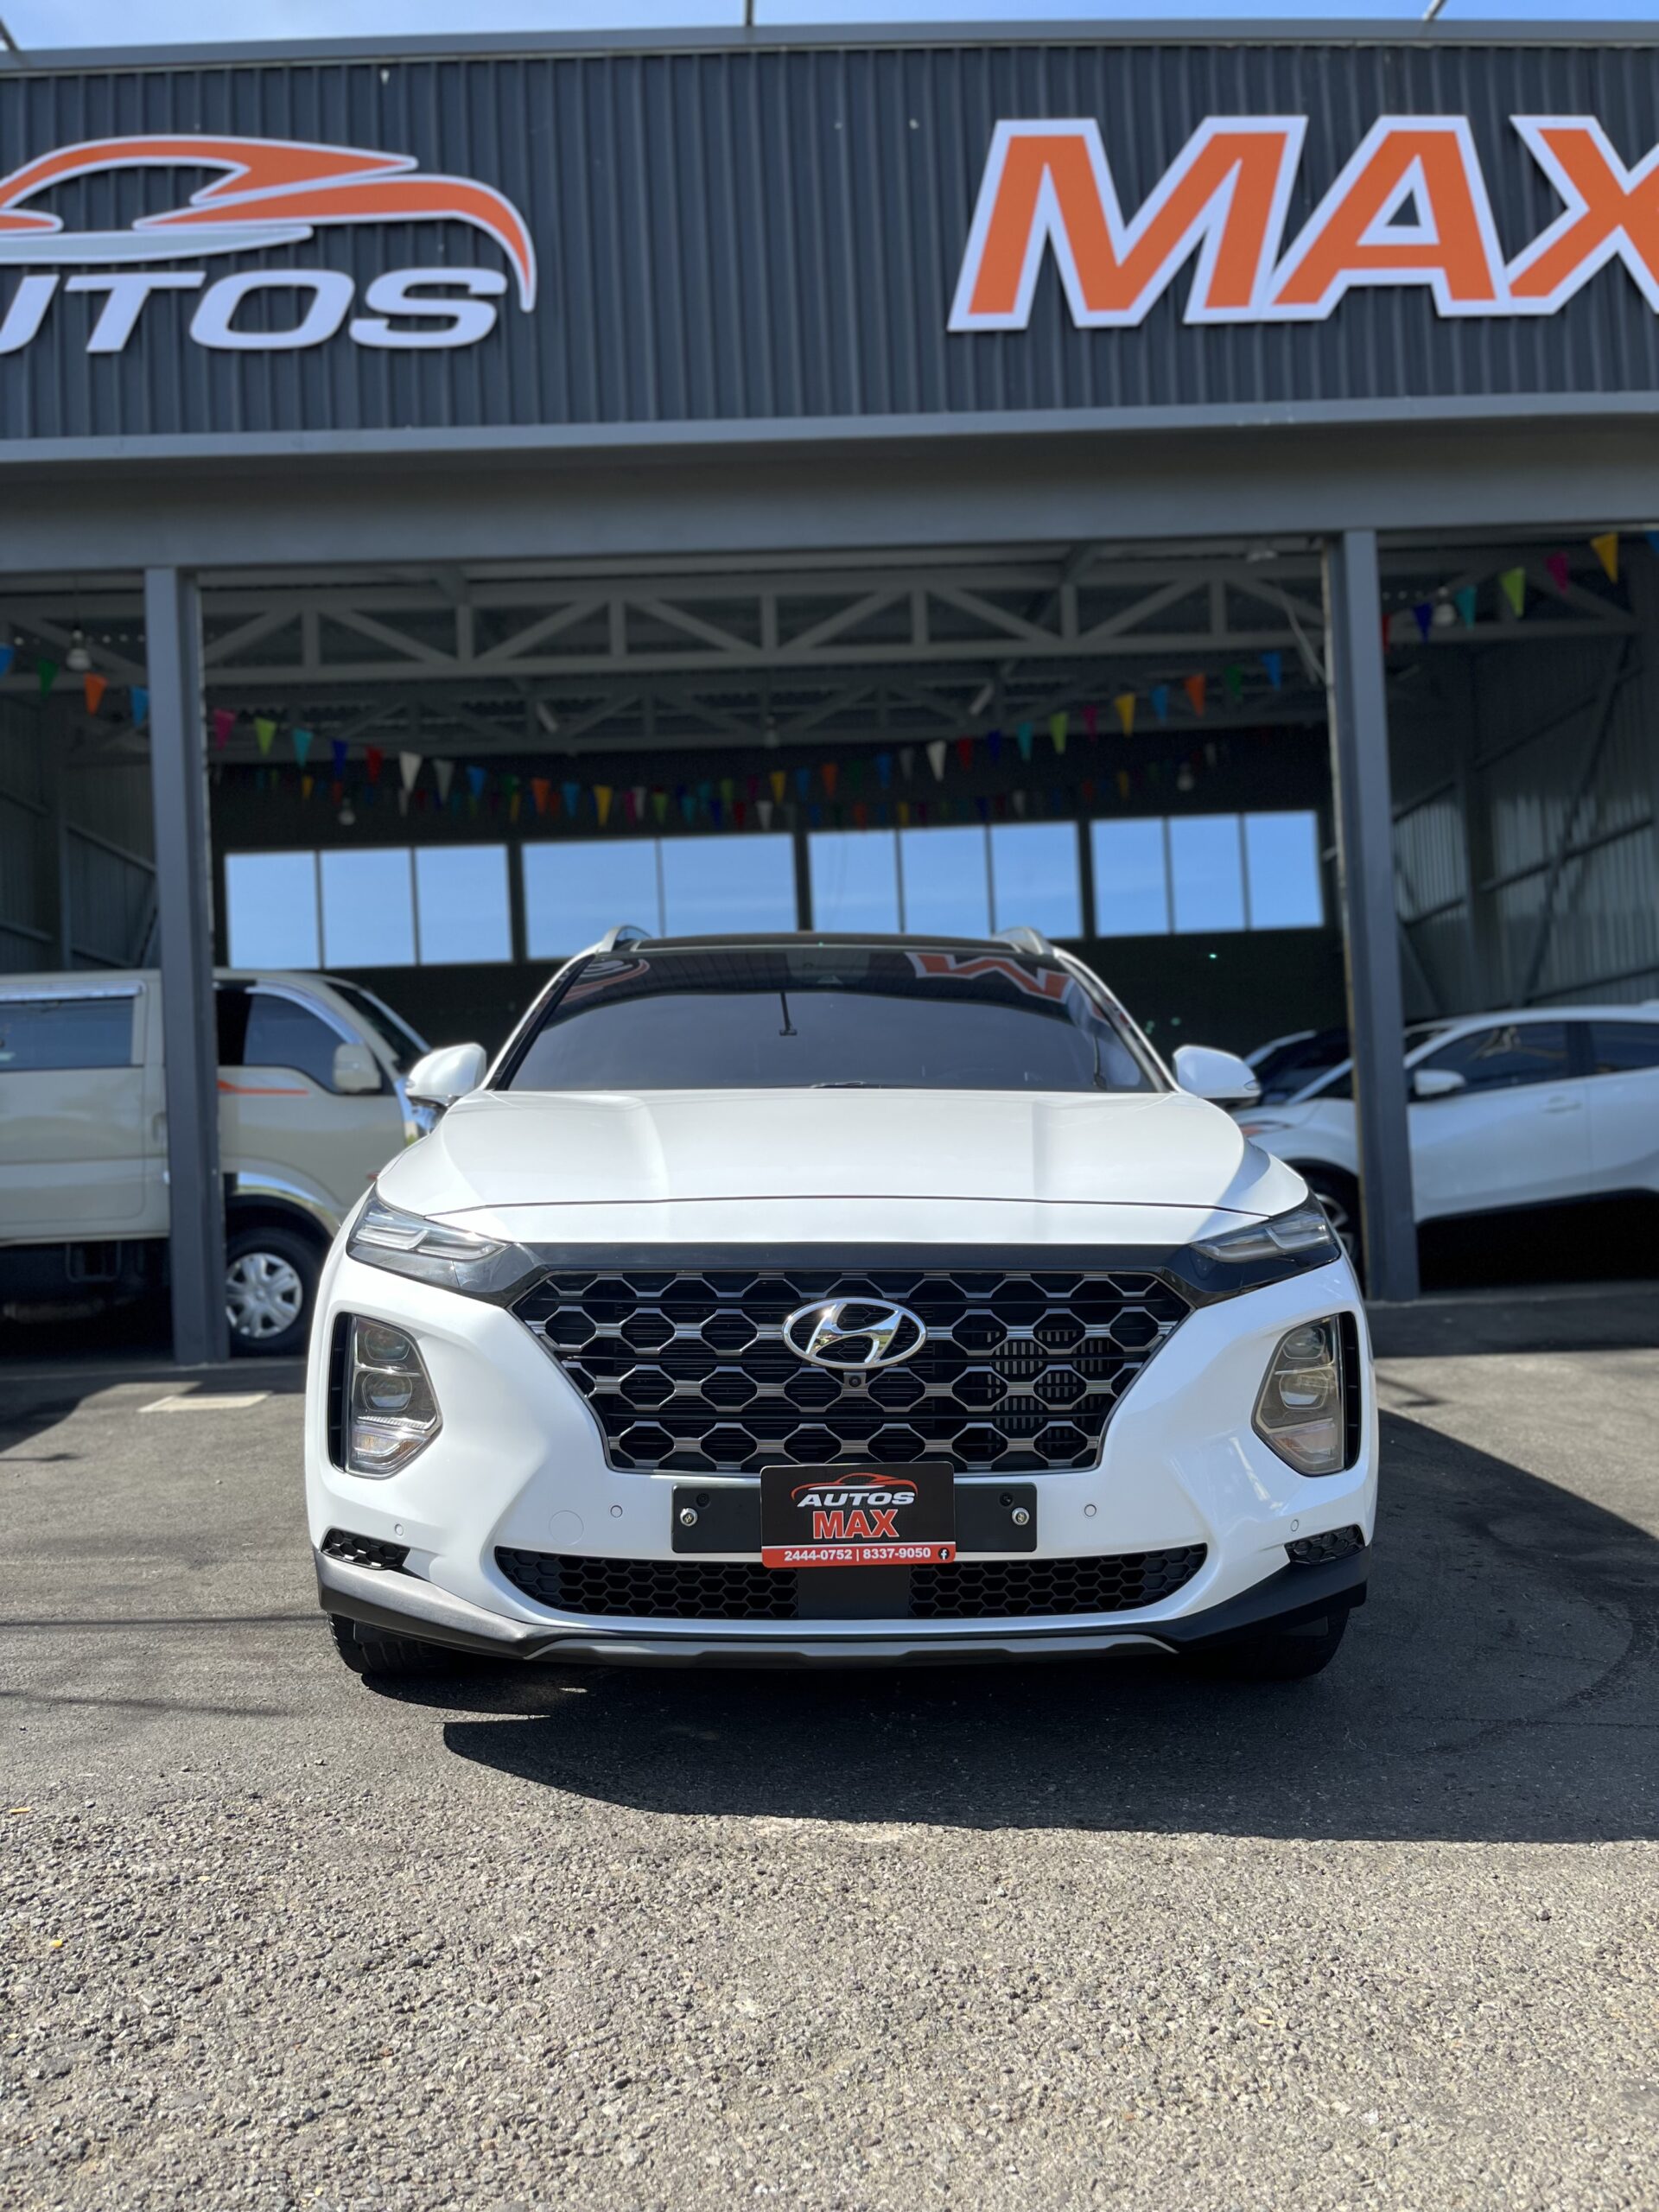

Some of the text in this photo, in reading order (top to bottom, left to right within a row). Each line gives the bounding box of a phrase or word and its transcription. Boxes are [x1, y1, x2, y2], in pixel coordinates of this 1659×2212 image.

[947, 115, 1659, 332] MAX
[797, 1491, 916, 1508] AUTOS
[812, 1509, 900, 1540] MAX
[784, 1548, 853, 1561] 2444-0752
[862, 1548, 931, 1560] 8337-9050
